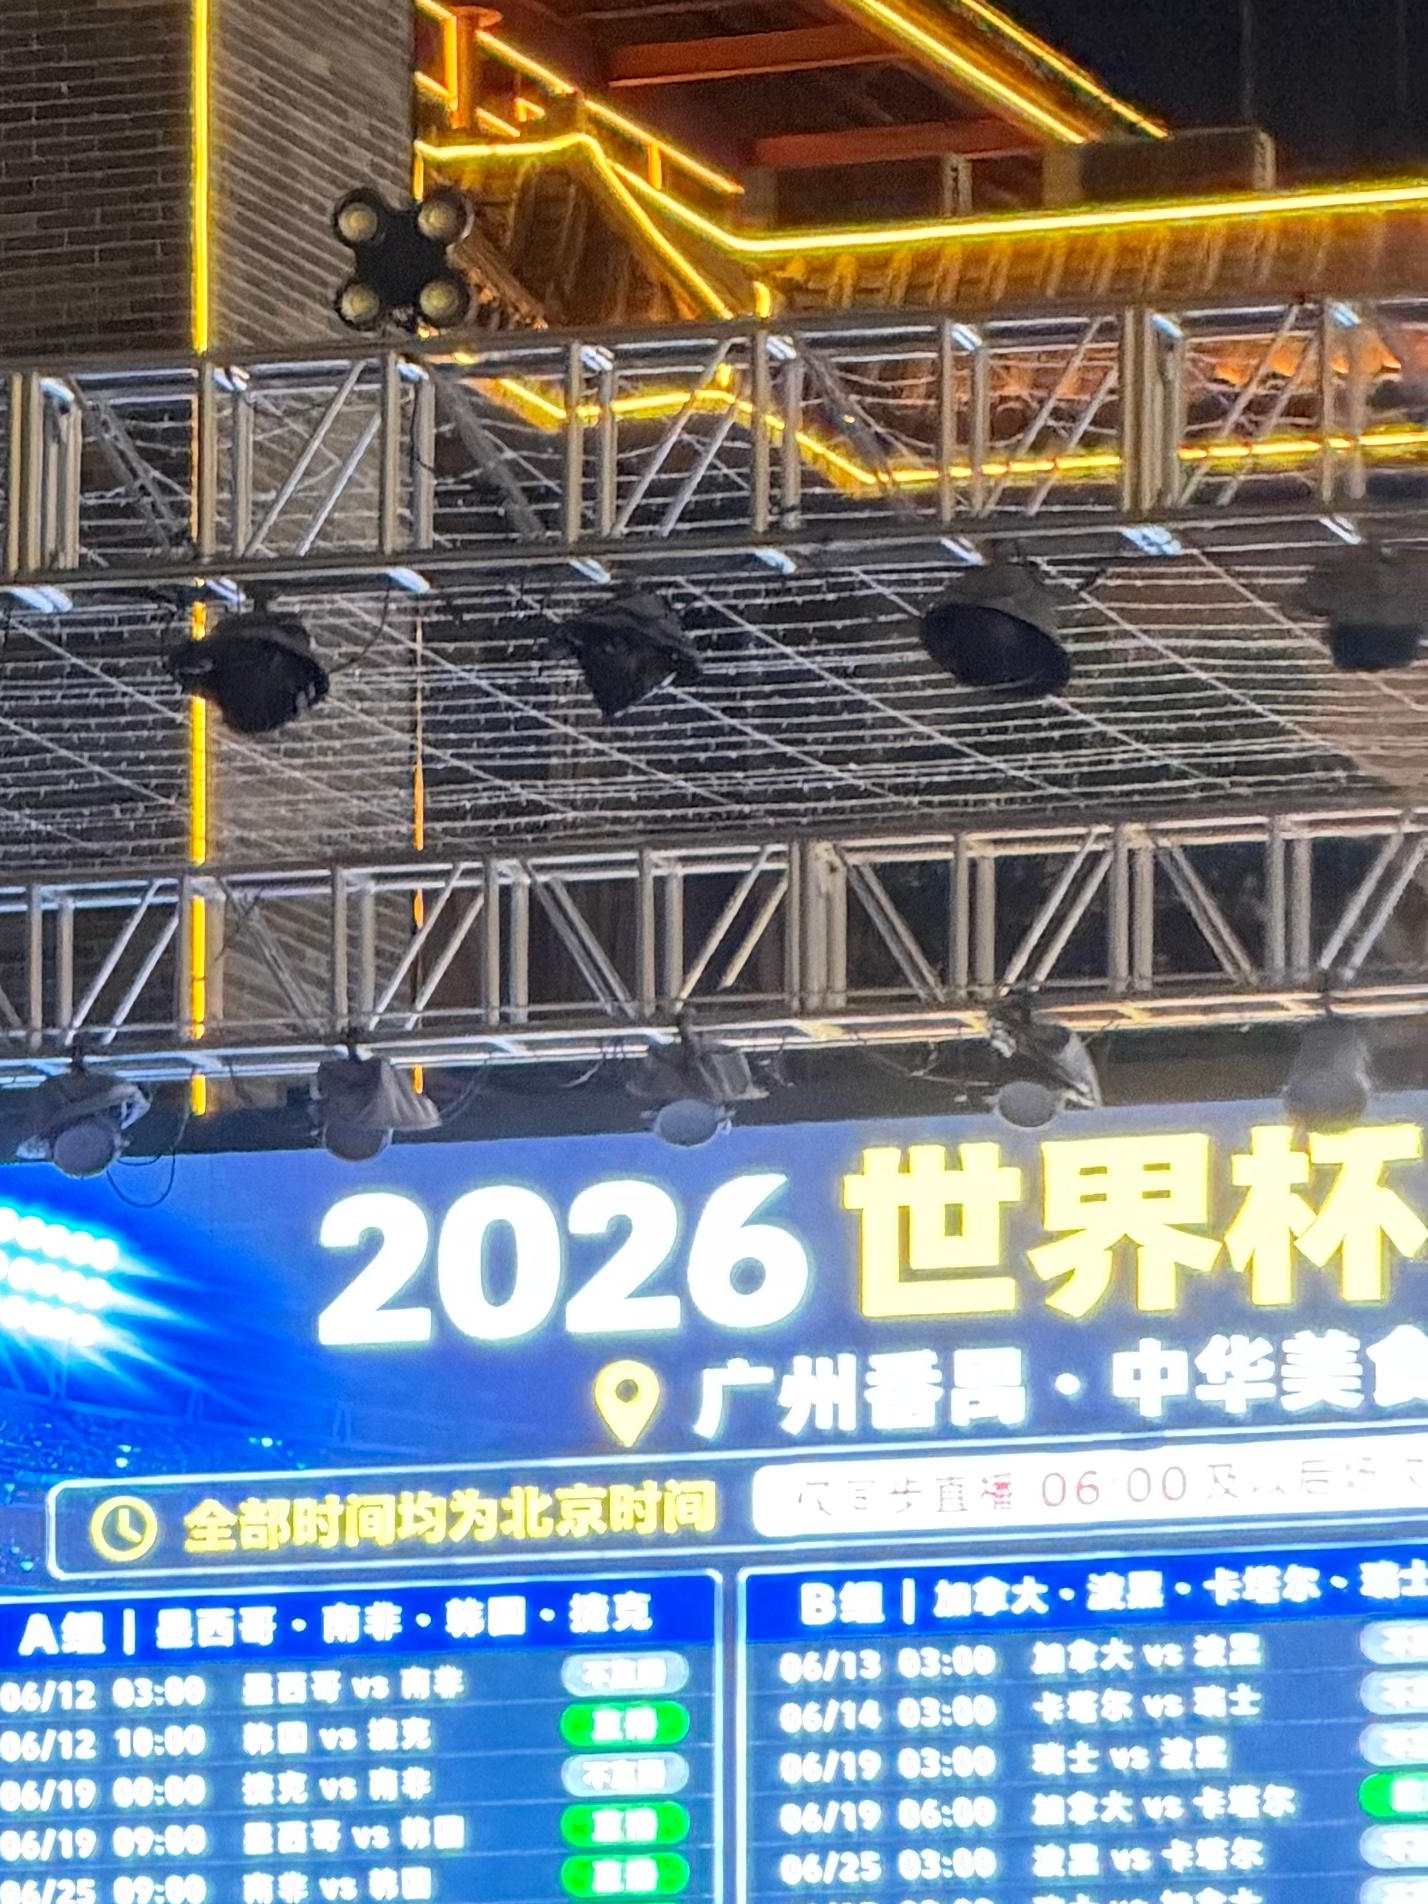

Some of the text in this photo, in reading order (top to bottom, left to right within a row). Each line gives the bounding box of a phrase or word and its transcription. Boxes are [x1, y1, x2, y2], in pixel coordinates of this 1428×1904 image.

[317, 1121, 1428, 1346] 2026 世界杯
[692, 1345, 1028, 1440] 广州番禺
[182, 1478, 718, 1554] 全部时间均为北京时间
[778, 1648, 882, 1685] 06/13
[1142, 1643, 1185, 1670] vs
[351, 1675, 390, 1700] vs
[778, 1698, 883, 1734] 06/14
[1141, 1694, 1185, 1720] vs
[318, 1727, 358, 1751] vs
[779, 1749, 883, 1785] 06/19
[1108, 1745, 1151, 1773] vs
[318, 1776, 358, 1801] vs
[778, 1799, 882, 1836] 06/19
[1141, 1795, 1186, 1821] vs
[351, 1825, 391, 1850] vs
[779, 1850, 883, 1886] 06/25
[1110, 1847, 1153, 1874] vs
[318, 1876, 358, 1901] vs
